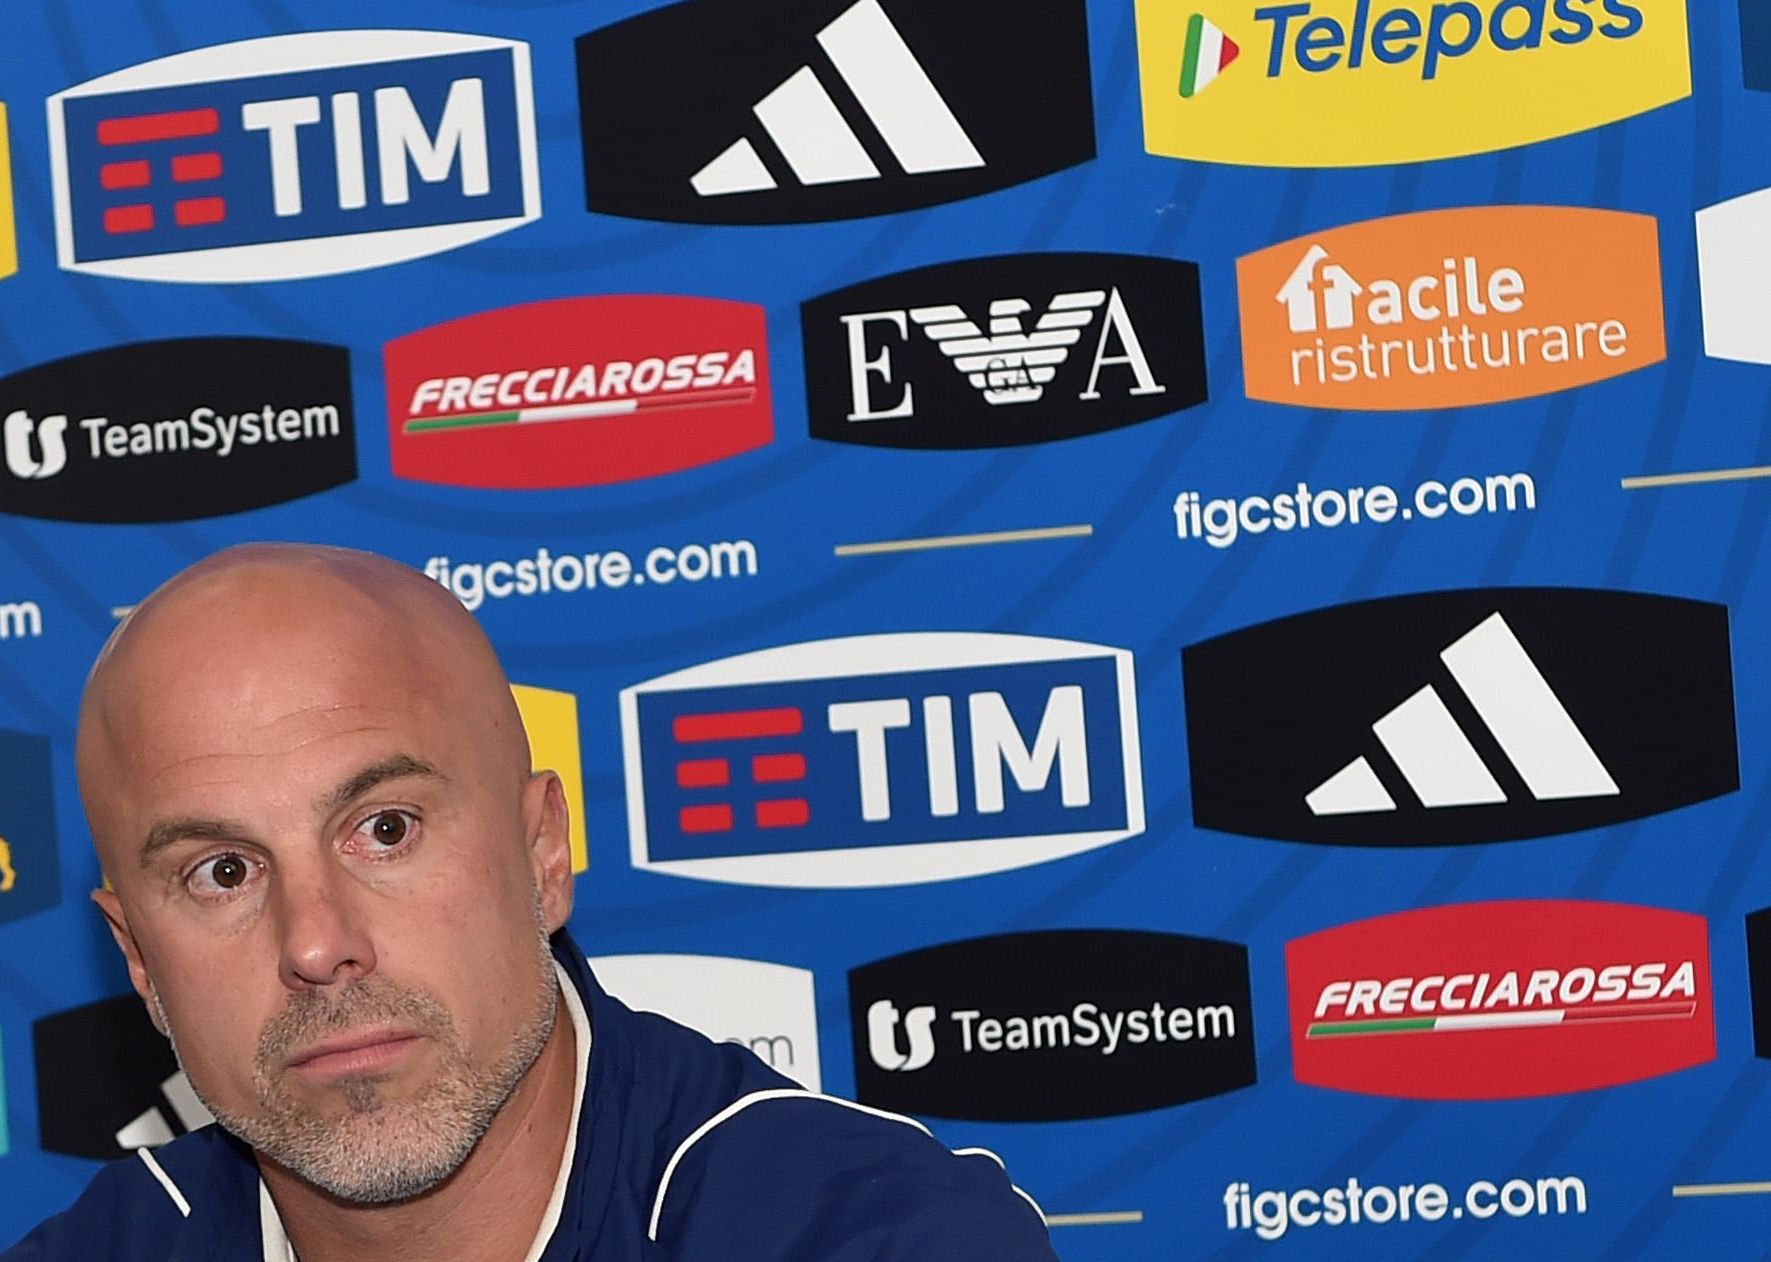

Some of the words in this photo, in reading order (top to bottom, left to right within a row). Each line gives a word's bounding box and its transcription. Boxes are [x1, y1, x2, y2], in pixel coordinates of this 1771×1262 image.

[1255, 0, 1643, 80] Telepass
[242, 77, 490, 217] TIM
[411, 350, 755, 415] FRECCIAROSSA
[1290, 318, 1627, 386] ristrutturare
[81, 406, 338, 456] TeamSystem
[1174, 474, 1535, 547] figcstore.com
[829, 686, 1089, 820] TIM
[1315, 962, 1695, 1017] FRECCIAROSSA
[952, 1003, 1234, 1053] TeamSystem
[1224, 1177, 1586, 1239] figcstore.com
